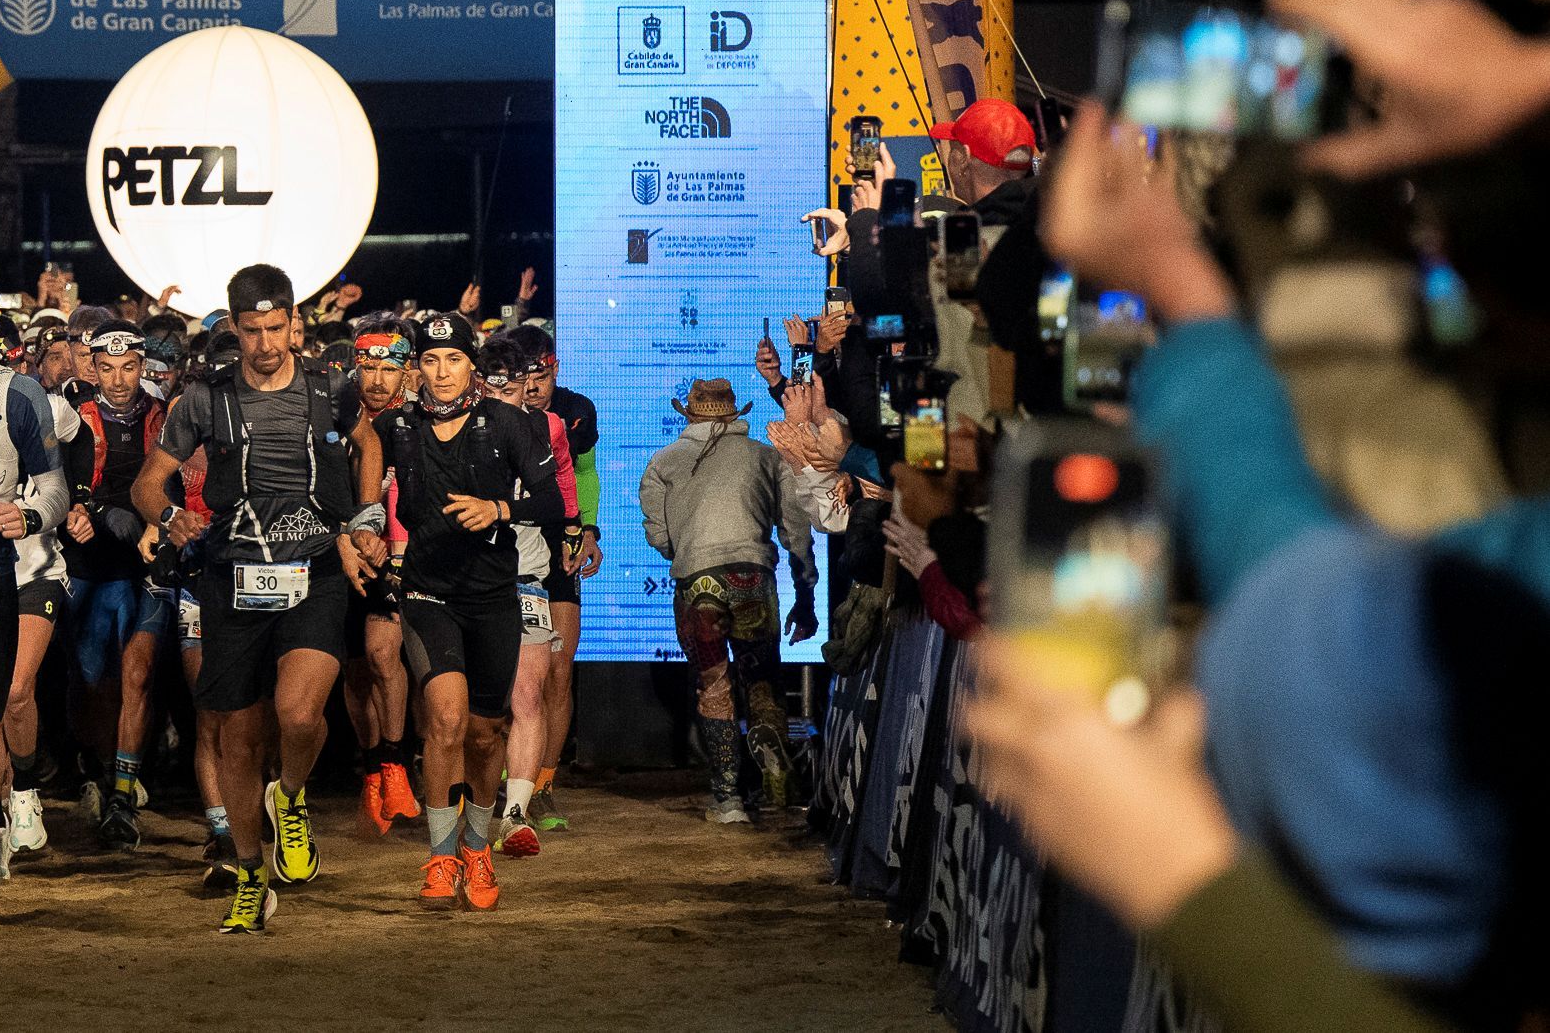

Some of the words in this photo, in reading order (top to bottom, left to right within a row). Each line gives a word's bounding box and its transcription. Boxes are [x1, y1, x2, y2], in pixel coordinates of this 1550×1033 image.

[379, 4, 403, 19] Las
[408, 3, 462, 19] Palmas
[466, 3, 486, 18] de
[490, 1, 529, 18] Gran
[70, 12, 98, 31] de
[103, 12, 155, 33] Gran
[628, 52, 660, 61] Cabildo
[624, 60, 645, 69] Gran
[669, 96, 699, 109] THE
[645, 110, 699, 124] NORTH
[660, 125, 699, 138] FACE
[666, 171, 746, 181] Ayuntamiento
[103, 146, 273, 234] PETZL
[685, 181, 703, 191] Las
[707, 181, 746, 191] Palmas
[681, 192, 706, 202] Gran
[708, 192, 745, 202] Canaria
[255, 575, 278, 591] 30
